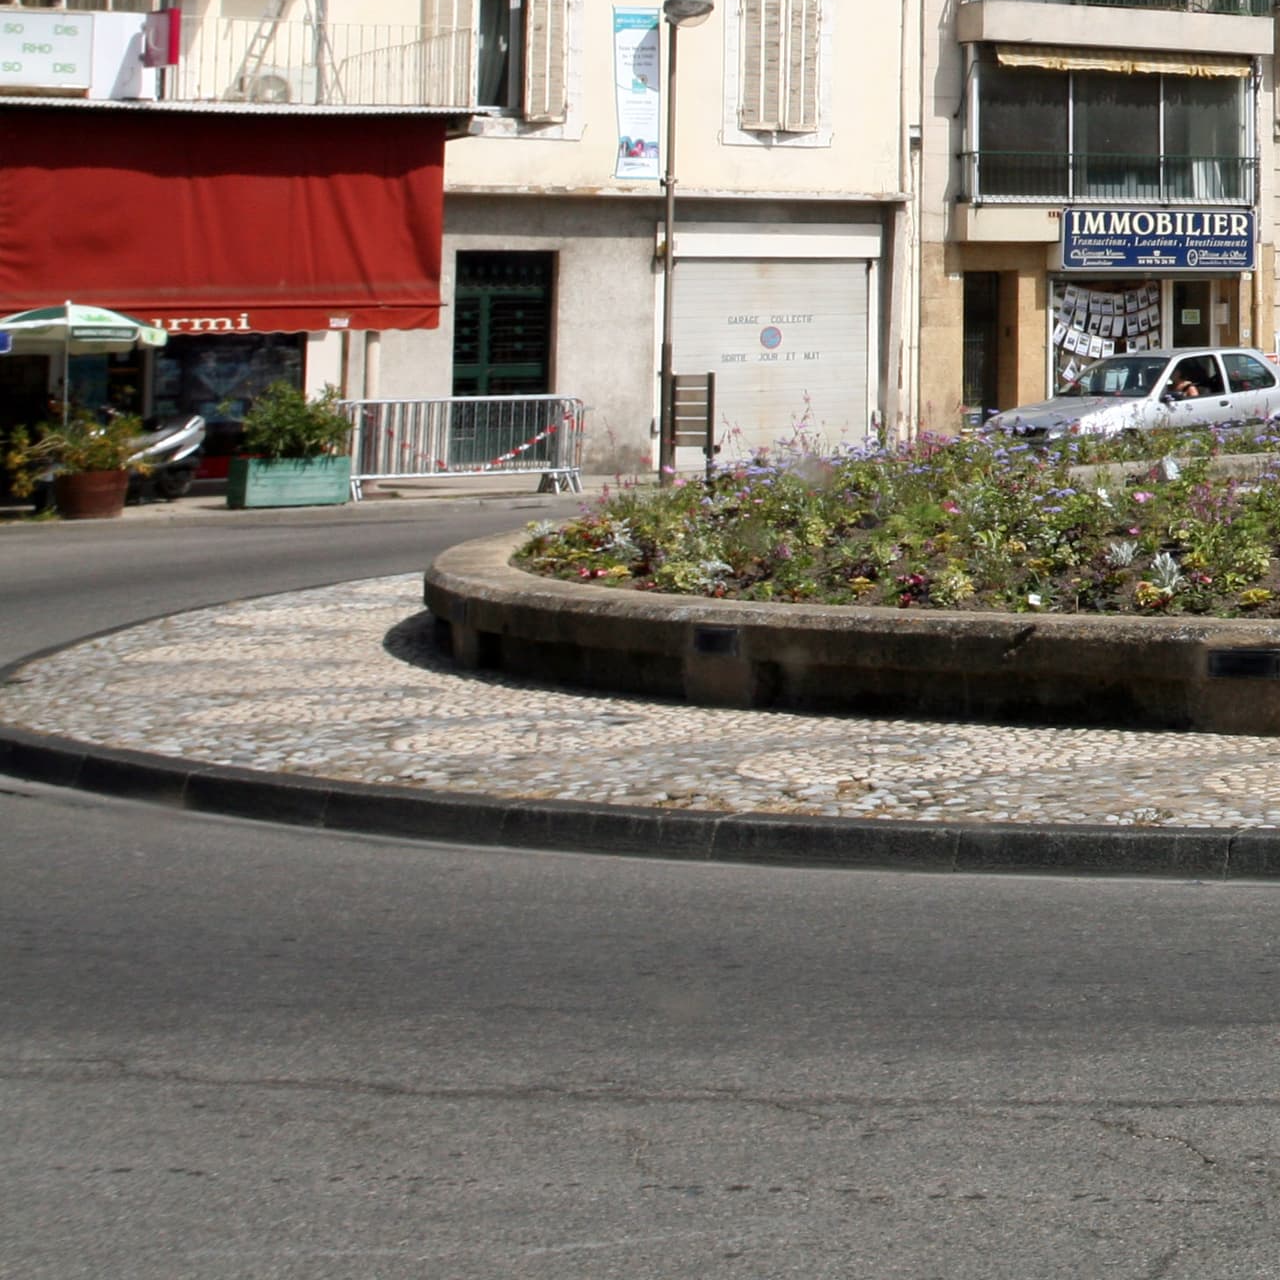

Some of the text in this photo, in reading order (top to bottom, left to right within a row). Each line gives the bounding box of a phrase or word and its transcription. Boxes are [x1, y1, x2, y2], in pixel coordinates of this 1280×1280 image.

[54, 24, 79, 36] DIS
[22, 42, 53, 54] RHO
[53, 63, 77, 74] DIS
[1071, 211, 1248, 236] IMMOBILIER
[1186, 237, 1247, 247] Investissements
[728, 314, 814, 325] GARAGE COLLECTIF
[721, 353, 747, 363] SORTIE
[759, 352, 778, 361] JOUR
[786, 352, 796, 361] ET
